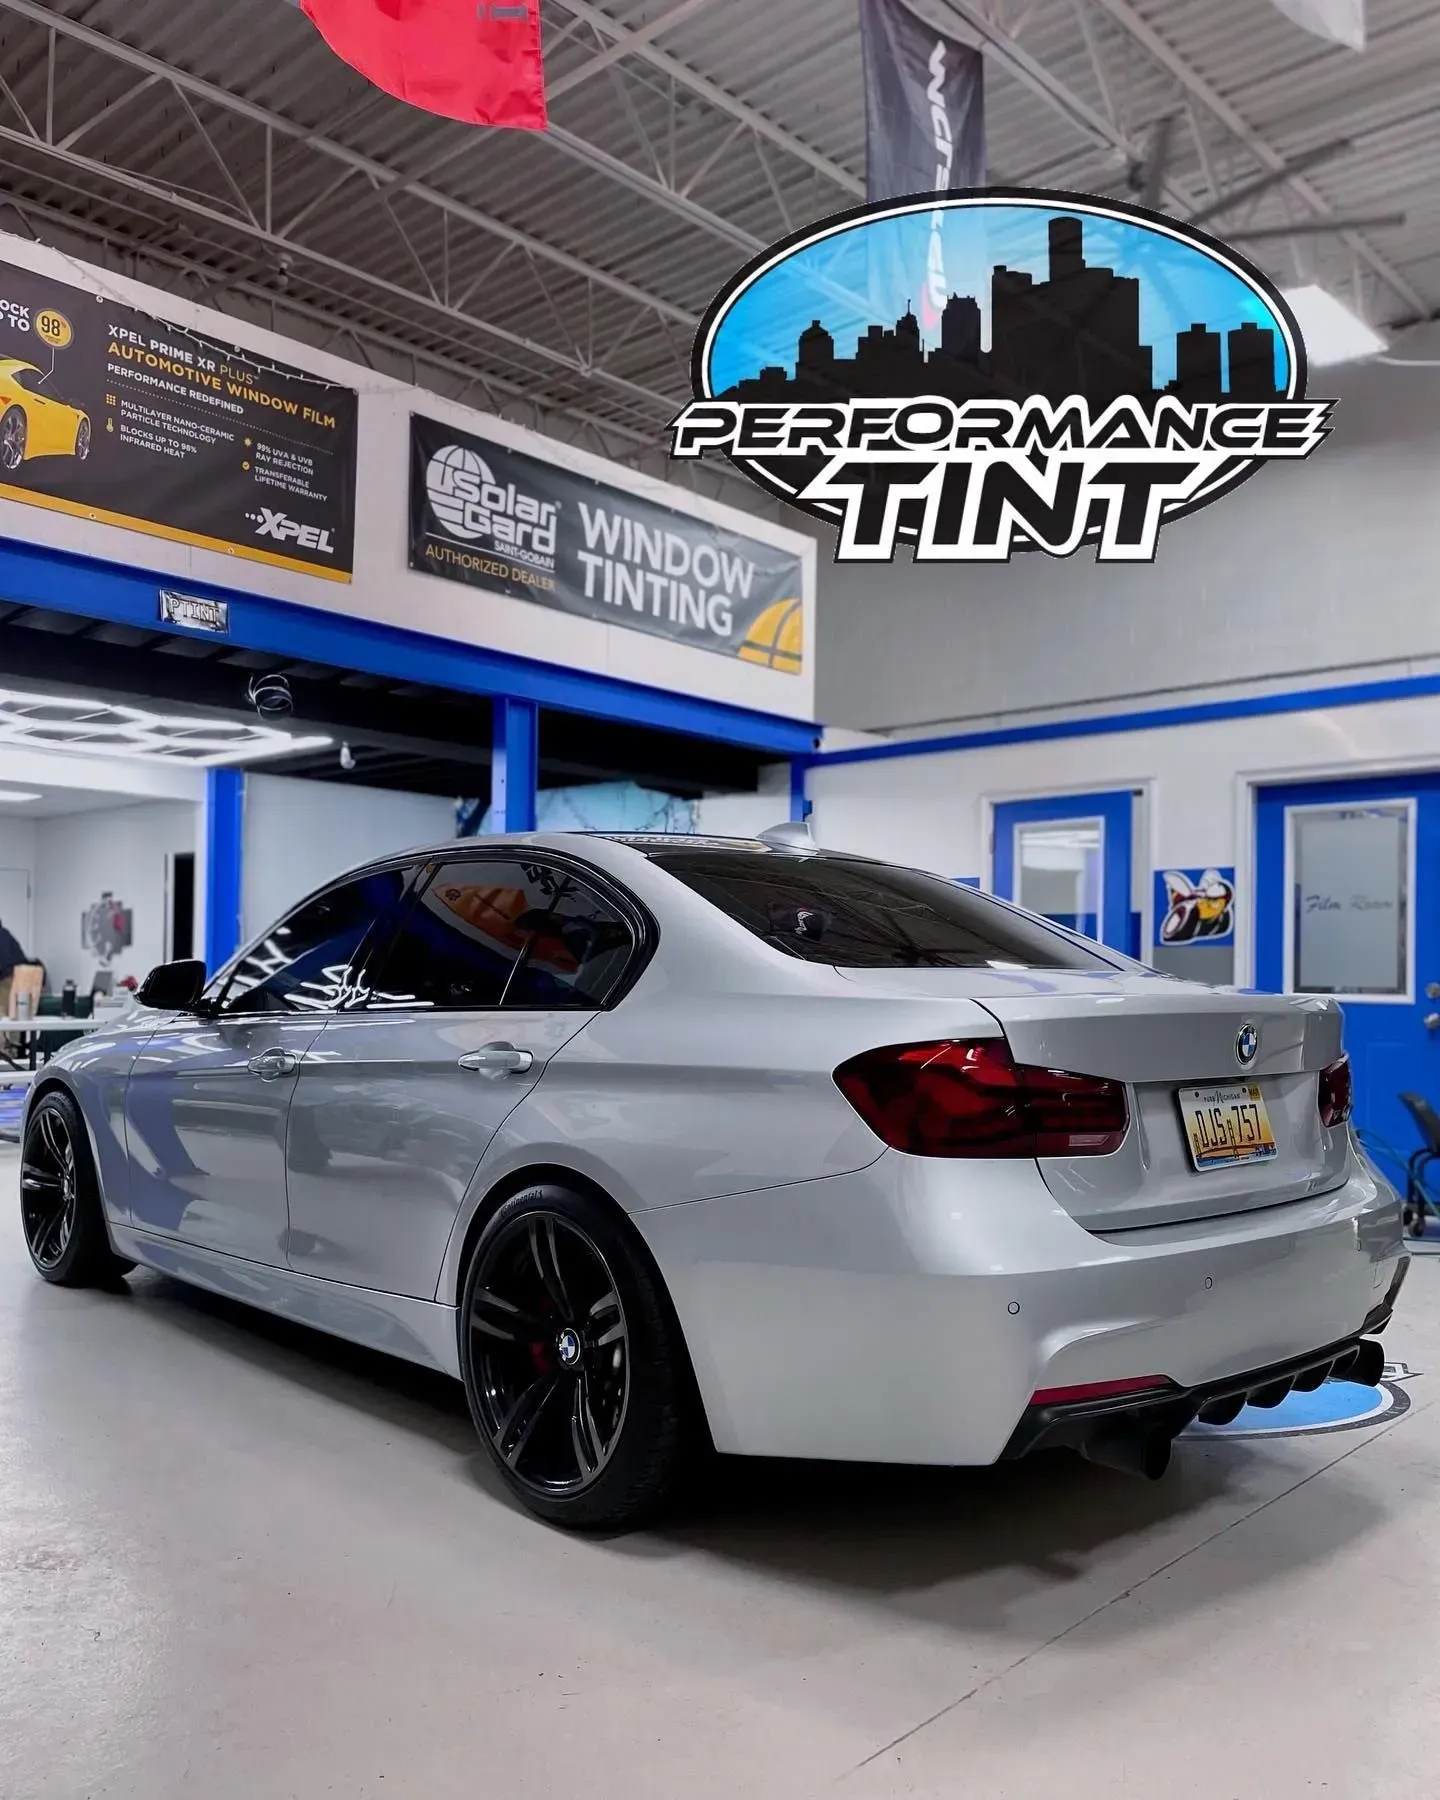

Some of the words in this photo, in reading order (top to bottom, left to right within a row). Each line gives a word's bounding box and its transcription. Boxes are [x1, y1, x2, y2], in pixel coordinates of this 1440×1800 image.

[7, 313, 30, 332] TO
[108, 324, 146, 347] XPEL
[150, 339, 193, 364] PRIME
[197, 356, 216, 372] XR
[220, 364, 254, 385] PLUS
[107, 363, 187, 396] PERFORMANCE
[189, 389, 244, 414] REDEFINED
[108, 341, 222, 390] AUTOMOTIVE
[226, 382, 299, 415] WINDOW
[303, 406, 336, 428] FILM
[120, 424, 154, 440] BLOCKS
[155, 434, 167, 444] UP
[168, 438, 179, 448] TO
[181, 442, 197, 454] 98%
[121, 400, 172, 422] MULTILAYER
[173, 416, 235, 442] NANO-CERAMIC
[121, 409, 161, 428] PARTICLE
[162, 422, 216, 445] TECHNOLOGY
[120, 433, 162, 452] INFRARED
[163, 447, 186, 459] HEAT
[255, 452, 271, 463] RAY
[273, 457, 314, 476] REJECTION
[256, 442, 271, 454] 99%
[272, 448, 289, 460] UVA
[291, 453, 297, 461] &
[298, 455, 313, 466] UVB
[254, 466, 310, 489] TRANSFERABLE
[254, 474, 287, 490] LIFETIME
[288, 483, 328, 502] WARRANTY
[453, 469, 557, 527] Solar
[255, 506, 334, 554] XPEL
[463, 501, 557, 556] Gard
[425, 543, 509, 578] AUTHORIZED
[511, 567, 556, 592] DEALER
[494, 540, 556, 569] SAINT-GOBAIN
[578, 502, 758, 600] WINDOW
[577, 550, 734, 638] TINTING
[1231, 1103, 1262, 1143] 757
